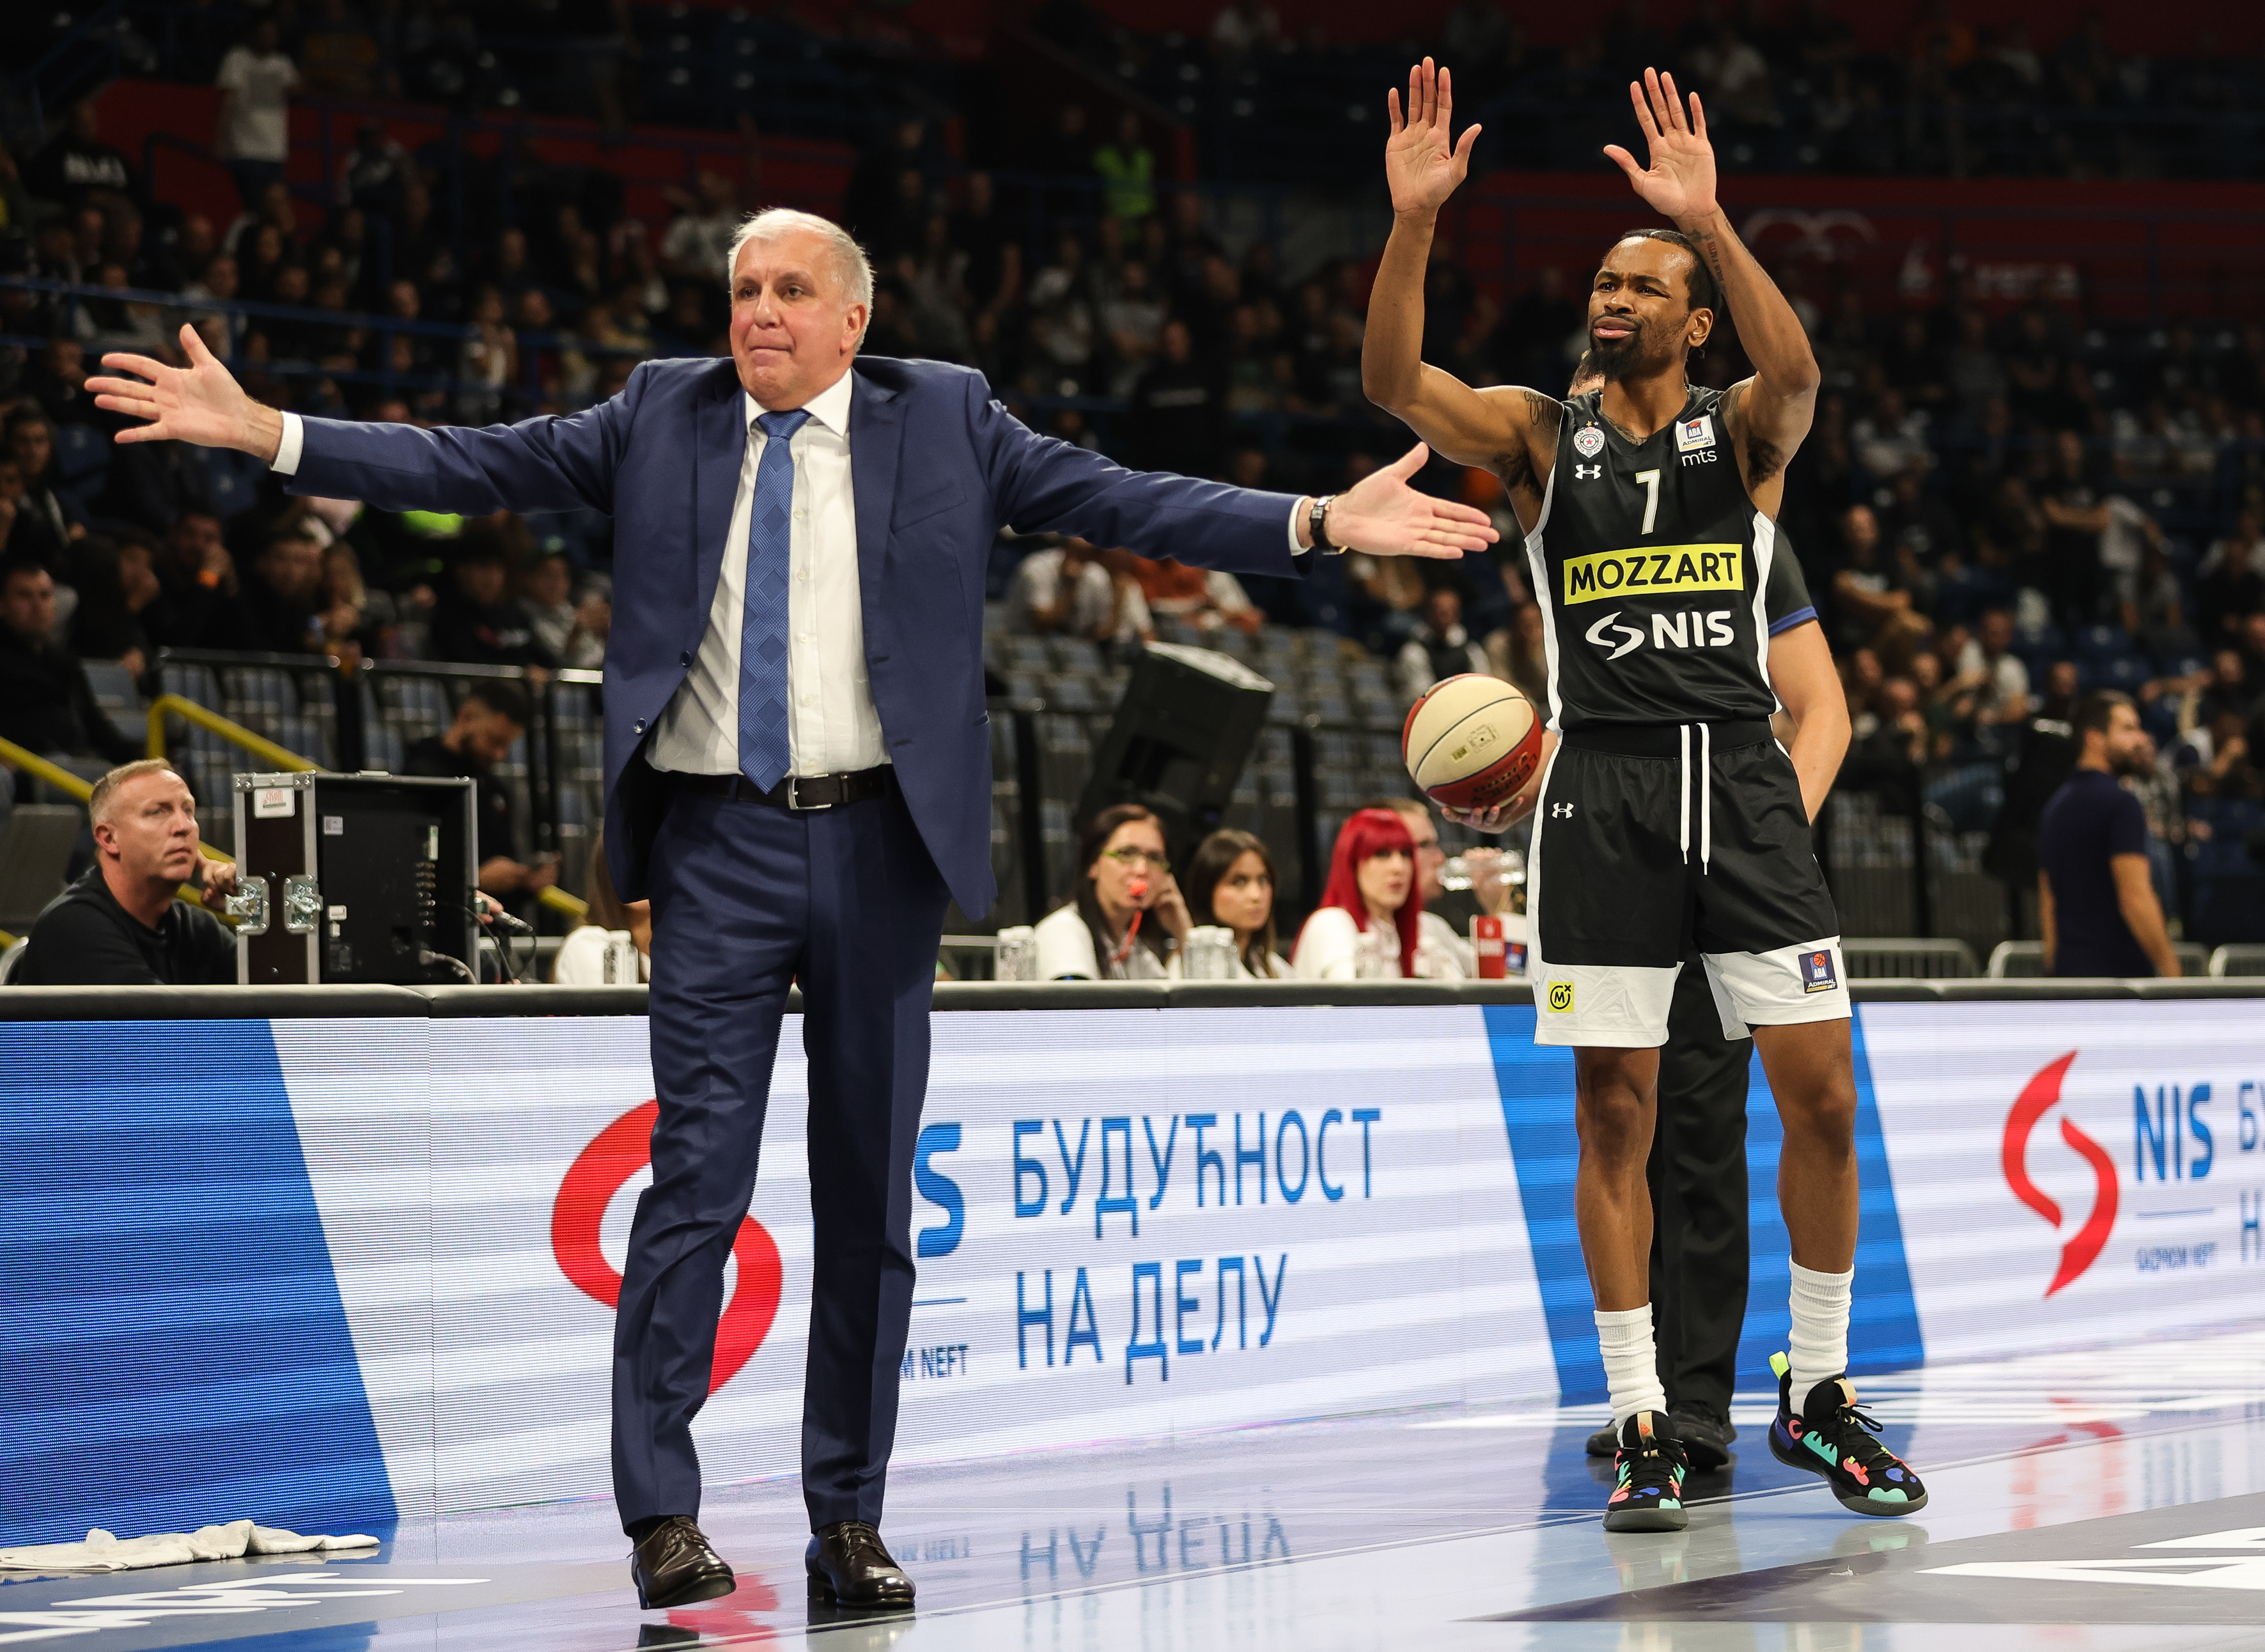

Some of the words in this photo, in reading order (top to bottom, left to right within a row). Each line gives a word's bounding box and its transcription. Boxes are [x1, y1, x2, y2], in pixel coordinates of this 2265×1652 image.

[1683, 436, 1713, 446] ADMIRAL
[1688, 427, 1701, 438] ABA
[1681, 449, 1717, 467] mts
[1636, 469, 1660, 534] 7
[1570, 552, 1737, 596] MOZZART
[1651, 611, 1734, 649] NIS
[1808, 978, 1836, 988] ADMIRAL
[1814, 967, 1826, 979] ABA
[2136, 1082, 2213, 1181] NIS
[1013, 1107, 1382, 1240] БУДУЋНОСТ
[1016, 1266, 1103, 1369] НА
[1125, 1252, 1288, 1385] ДЕЛУ
[921, 1344, 969, 1379] NEFT
